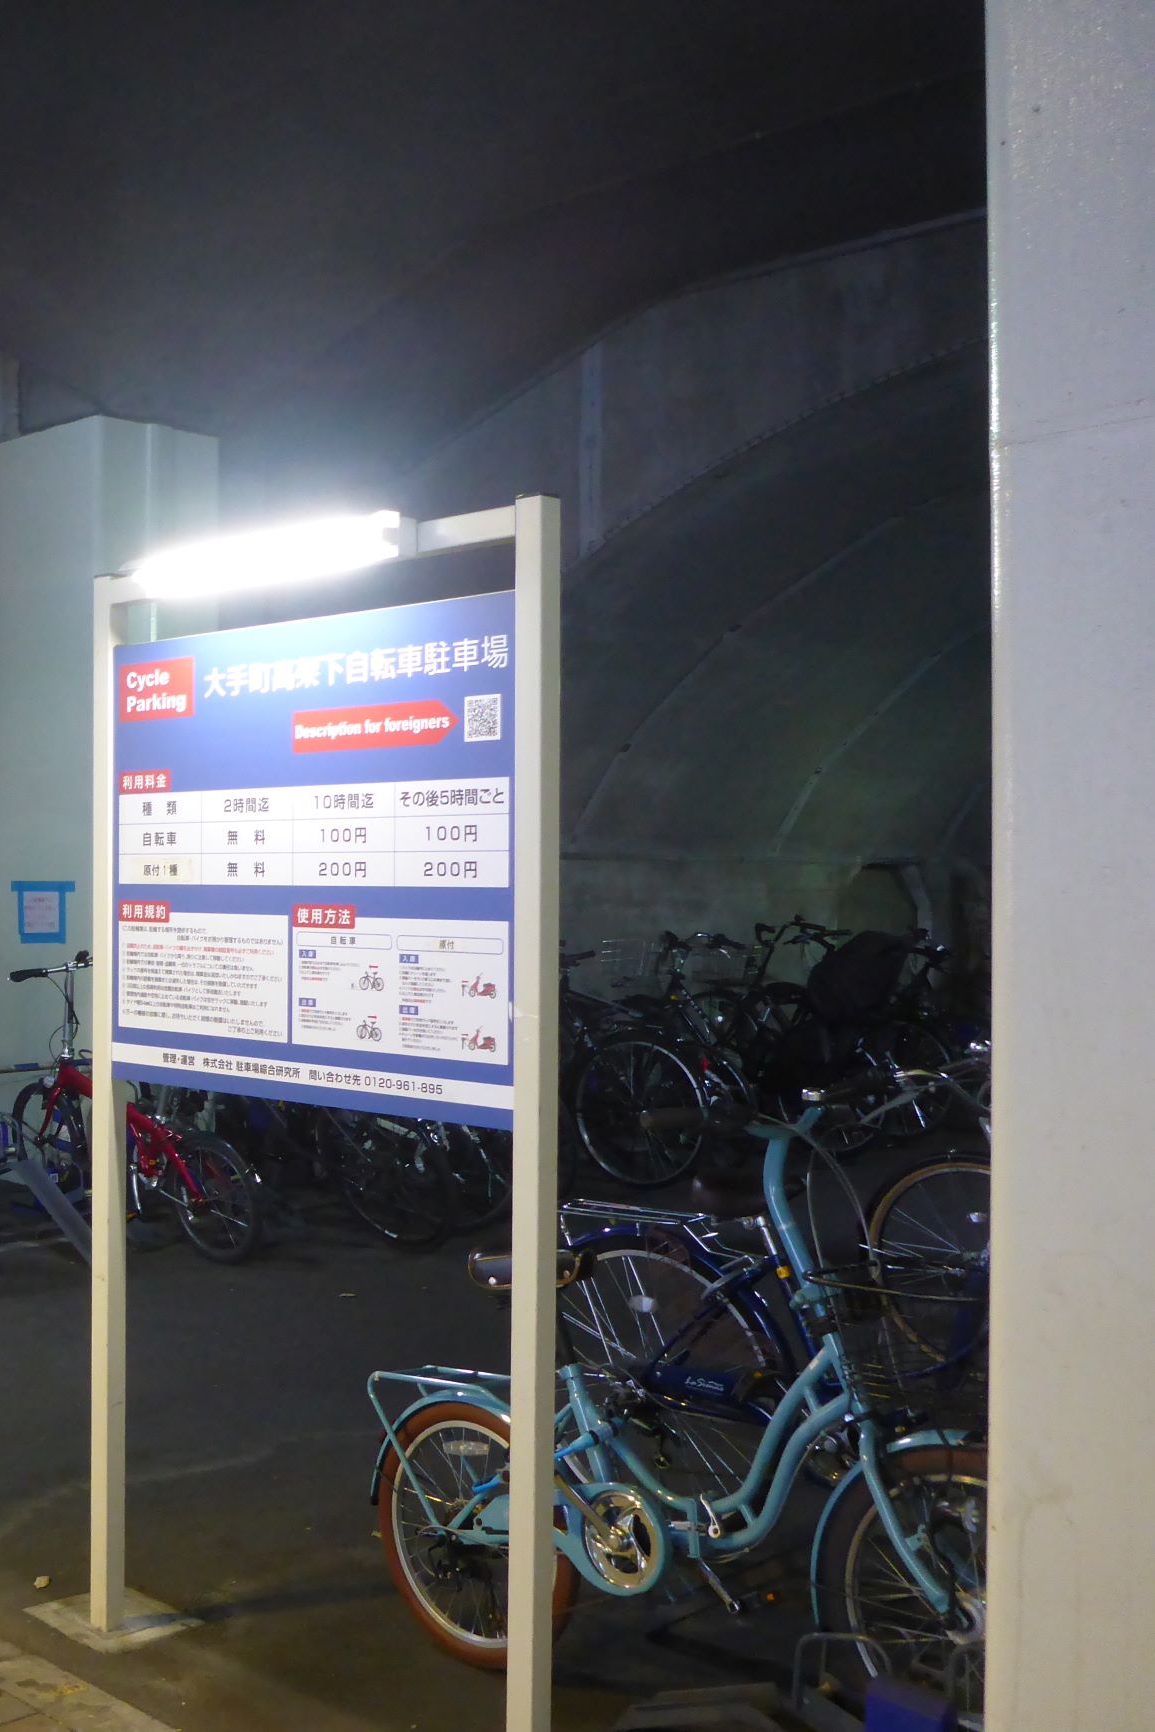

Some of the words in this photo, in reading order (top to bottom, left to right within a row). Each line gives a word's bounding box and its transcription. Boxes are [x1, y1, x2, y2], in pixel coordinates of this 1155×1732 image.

[203, 634, 508, 699] 大手町高架下自転車駐車場
[126, 668, 170, 692] Cycle
[126, 692, 187, 713] Parking
[294, 721, 361, 740] Description
[364, 718, 381, 733] for
[384, 716, 449, 734] foreigners
[122, 773, 167, 790] 利用料金
[223, 797, 270, 813] 2時間迄
[314, 793, 374, 810] 10時間迄
[399, 787, 505, 808] その後5時間ごと
[142, 831, 177, 847] 自転車
[320, 826, 367, 844] 100円
[425, 824, 478, 843] 100円
[318, 861, 367, 878] 200円
[423, 860, 478, 879] 200円
[122, 904, 166, 920] 利用規約
[297, 907, 351, 925] 使用方法
[330, 936, 357, 945] 自転車
[202, 1058, 233, 1071] 株式会社
[364, 1077, 443, 1095] 0120-961-895
